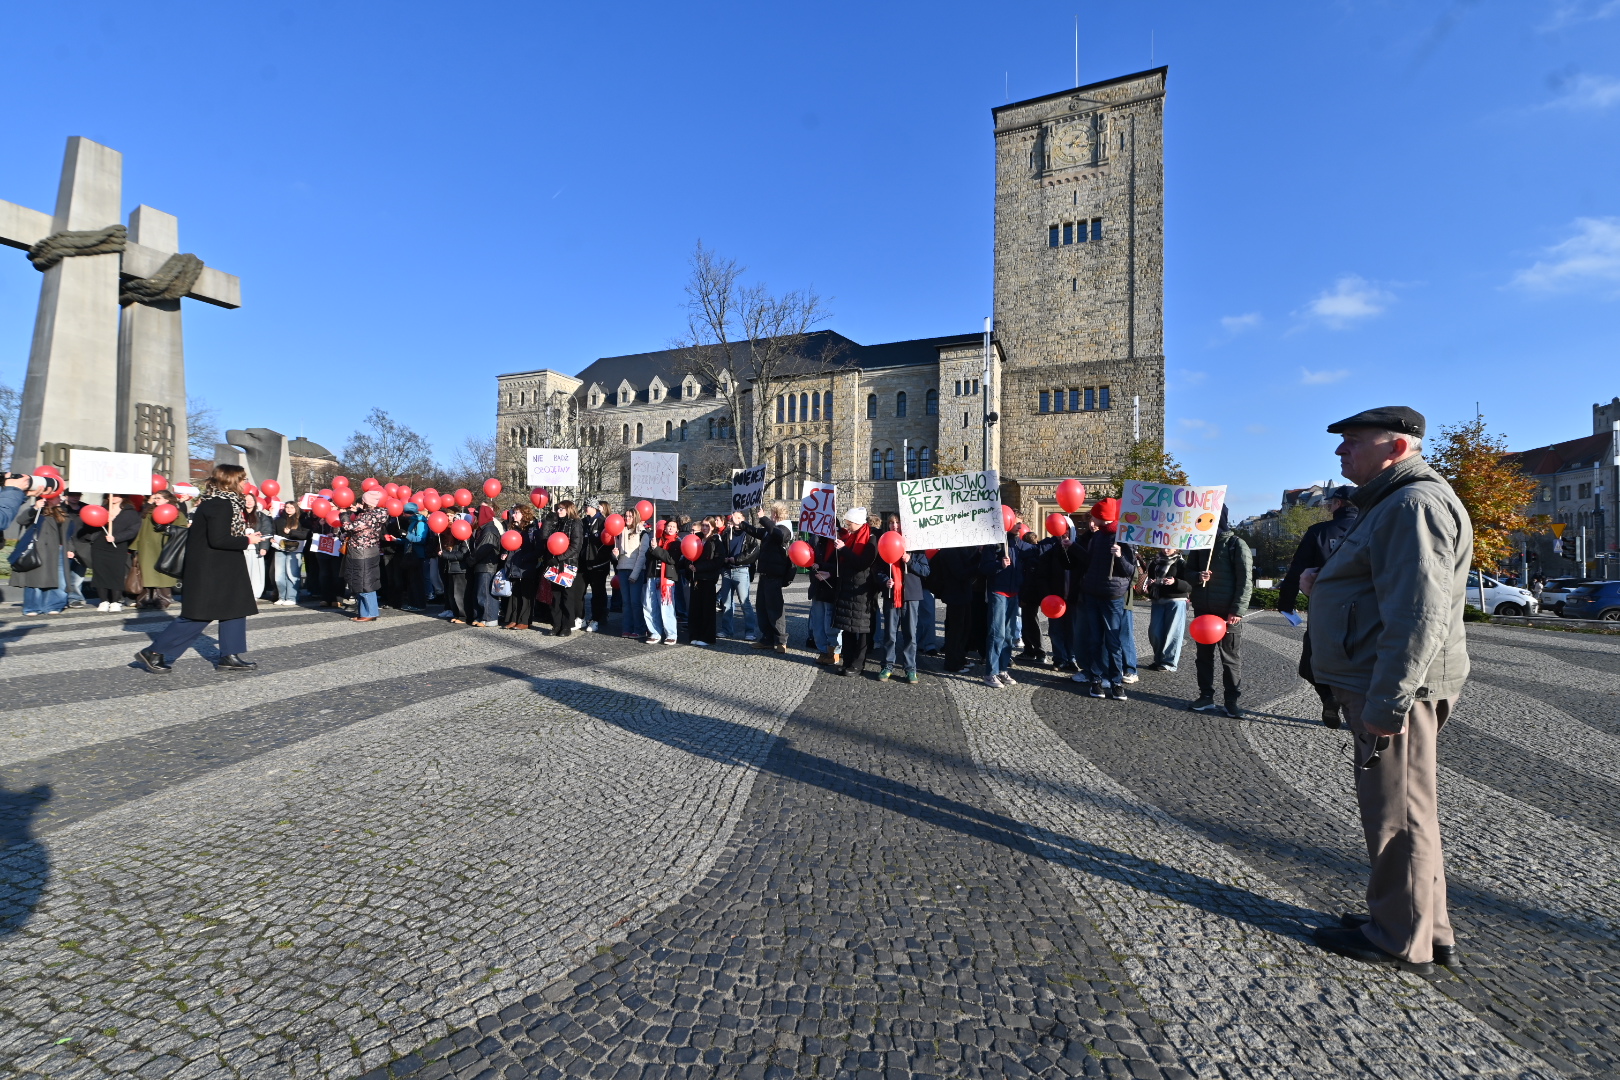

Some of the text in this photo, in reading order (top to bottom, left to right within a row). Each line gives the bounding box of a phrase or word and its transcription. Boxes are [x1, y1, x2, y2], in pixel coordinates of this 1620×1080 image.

[533, 455, 544, 463] NIE
[900, 474, 987, 496] DZIECIŃSTWO
[909, 487, 1001, 514] BEZ PRZEMOCY
[1130, 483, 1225, 511] SZACUNEK
[1141, 508, 1192, 525] BUDUJE
